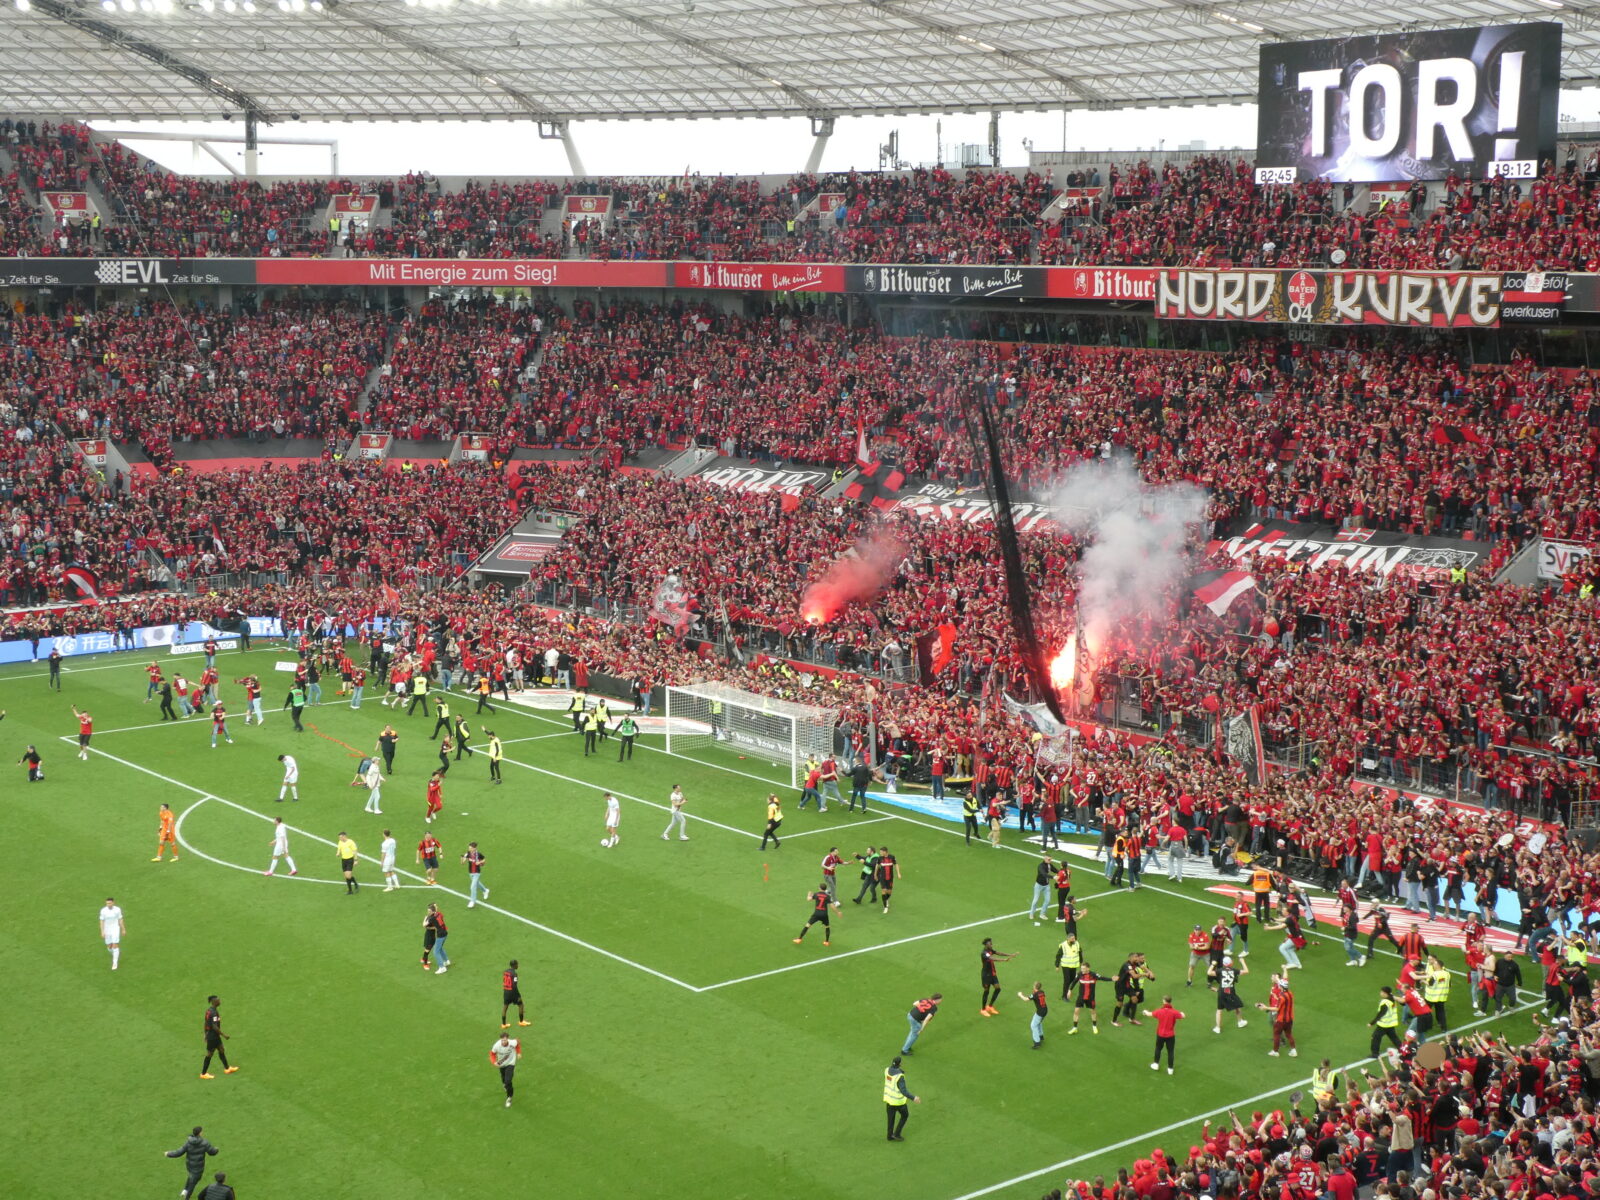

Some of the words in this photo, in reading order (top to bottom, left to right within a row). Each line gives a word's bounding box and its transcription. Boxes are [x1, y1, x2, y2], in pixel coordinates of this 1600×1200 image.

[1298, 51, 1525, 162] TOR!
[1260, 170, 1292, 182] 82:45
[1495, 163, 1531, 176] 19:12
[9, 275, 28, 284] Zeit
[29, 274, 43, 284] für
[44, 275, 62, 284] Sie.
[121, 260, 168, 283] EVL
[172, 274, 189, 283] Zeit
[190, 274, 204, 283] für
[205, 274, 222, 283] Sie.
[370, 264, 395, 280] Mit
[401, 264, 466, 284] Energie
[472, 267, 508, 281] zum
[514, 264, 557, 284] Sieg!
[704, 265, 762, 288] Bitburger
[792, 275, 806, 285] ein
[880, 268, 952, 293] Bitburger
[963, 276, 985, 293] Bitte
[986, 277, 1003, 289] ein
[1158, 271, 1276, 318] NORD
[1333, 273, 1500, 326] KURVE
[1288, 303, 1313, 322] 04
[1503, 306, 1559, 318] everkusen
[1086, 774, 1096, 785] 27
[818, 896, 826, 908] 7
[1299, 1171, 1315, 1186] 27
